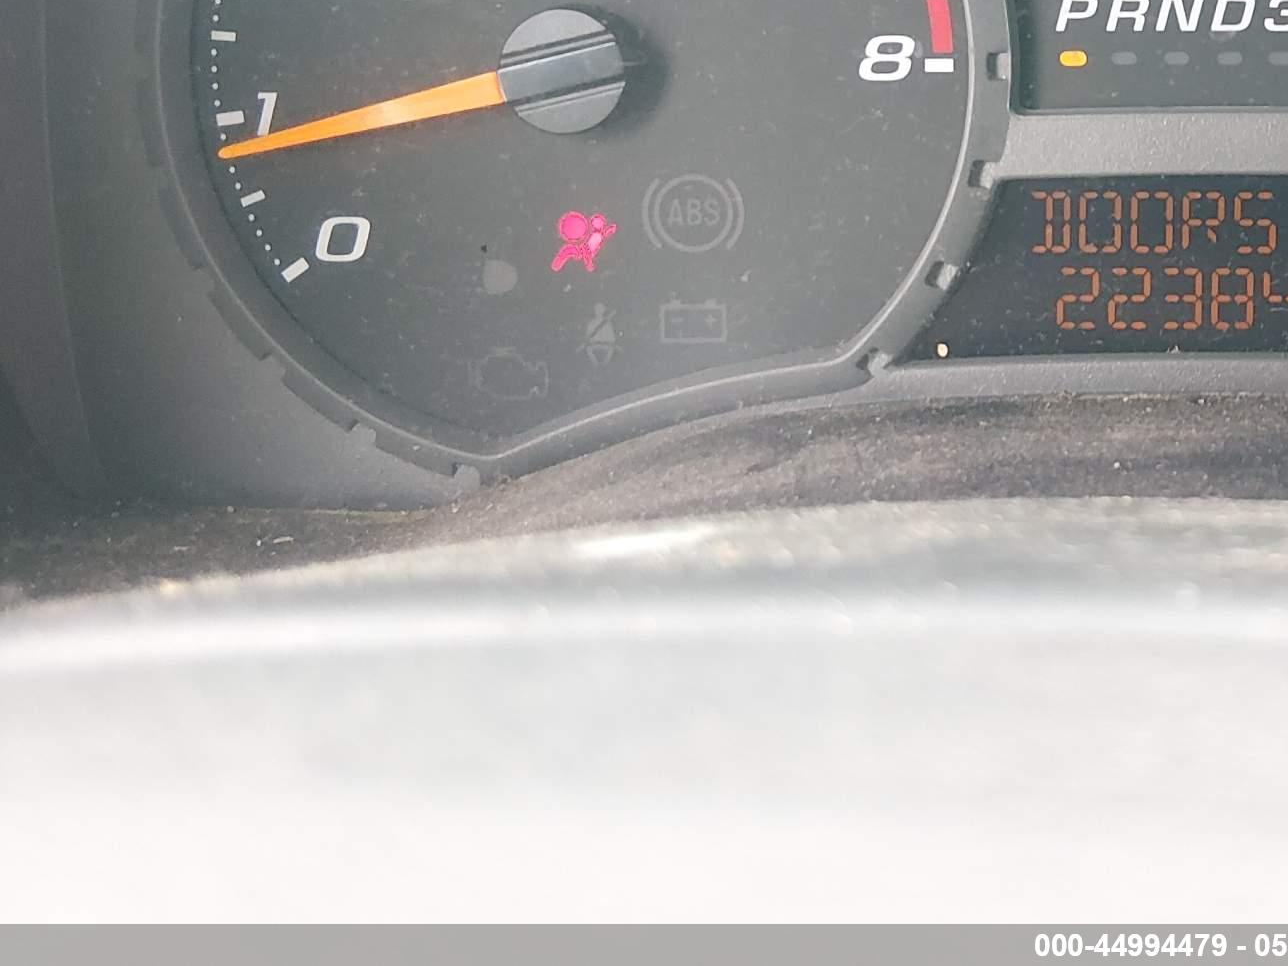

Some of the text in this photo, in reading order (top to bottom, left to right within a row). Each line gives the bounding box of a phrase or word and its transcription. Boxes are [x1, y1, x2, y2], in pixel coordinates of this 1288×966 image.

[858, 35, 916, 82] 8
[257, 92, 278, 136] 1
[667, 197, 721, 227] ABS
[1031, 190, 1278, 255] DOORS
[315, 216, 371, 262] 0
